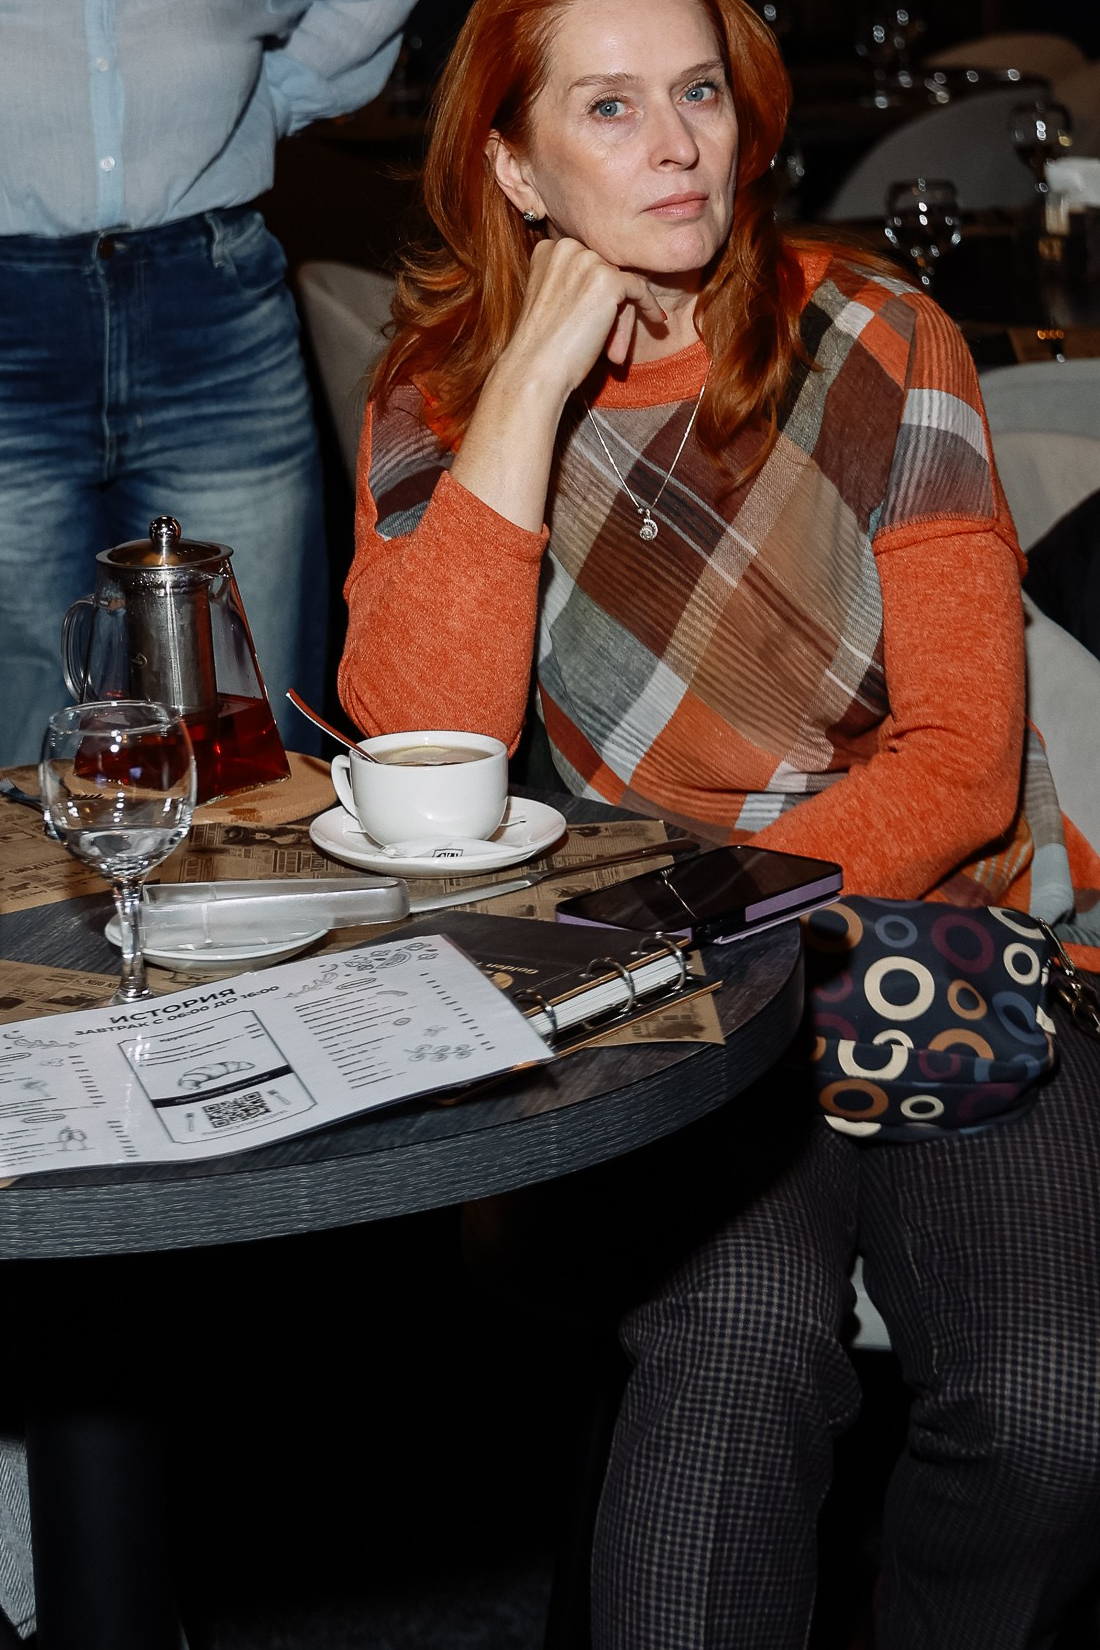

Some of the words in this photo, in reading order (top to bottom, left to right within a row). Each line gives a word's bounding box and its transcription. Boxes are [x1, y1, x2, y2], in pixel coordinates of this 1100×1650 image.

[486, 963, 539, 975] Golden
[74, 1021, 150, 1036] ЗАВТРАК
[167, 1006, 210, 1021] 06:00
[214, 997, 238, 1009] ДО
[240, 985, 280, 999] 16:00
[109, 988, 236, 1024] ИСТОРИЯ
